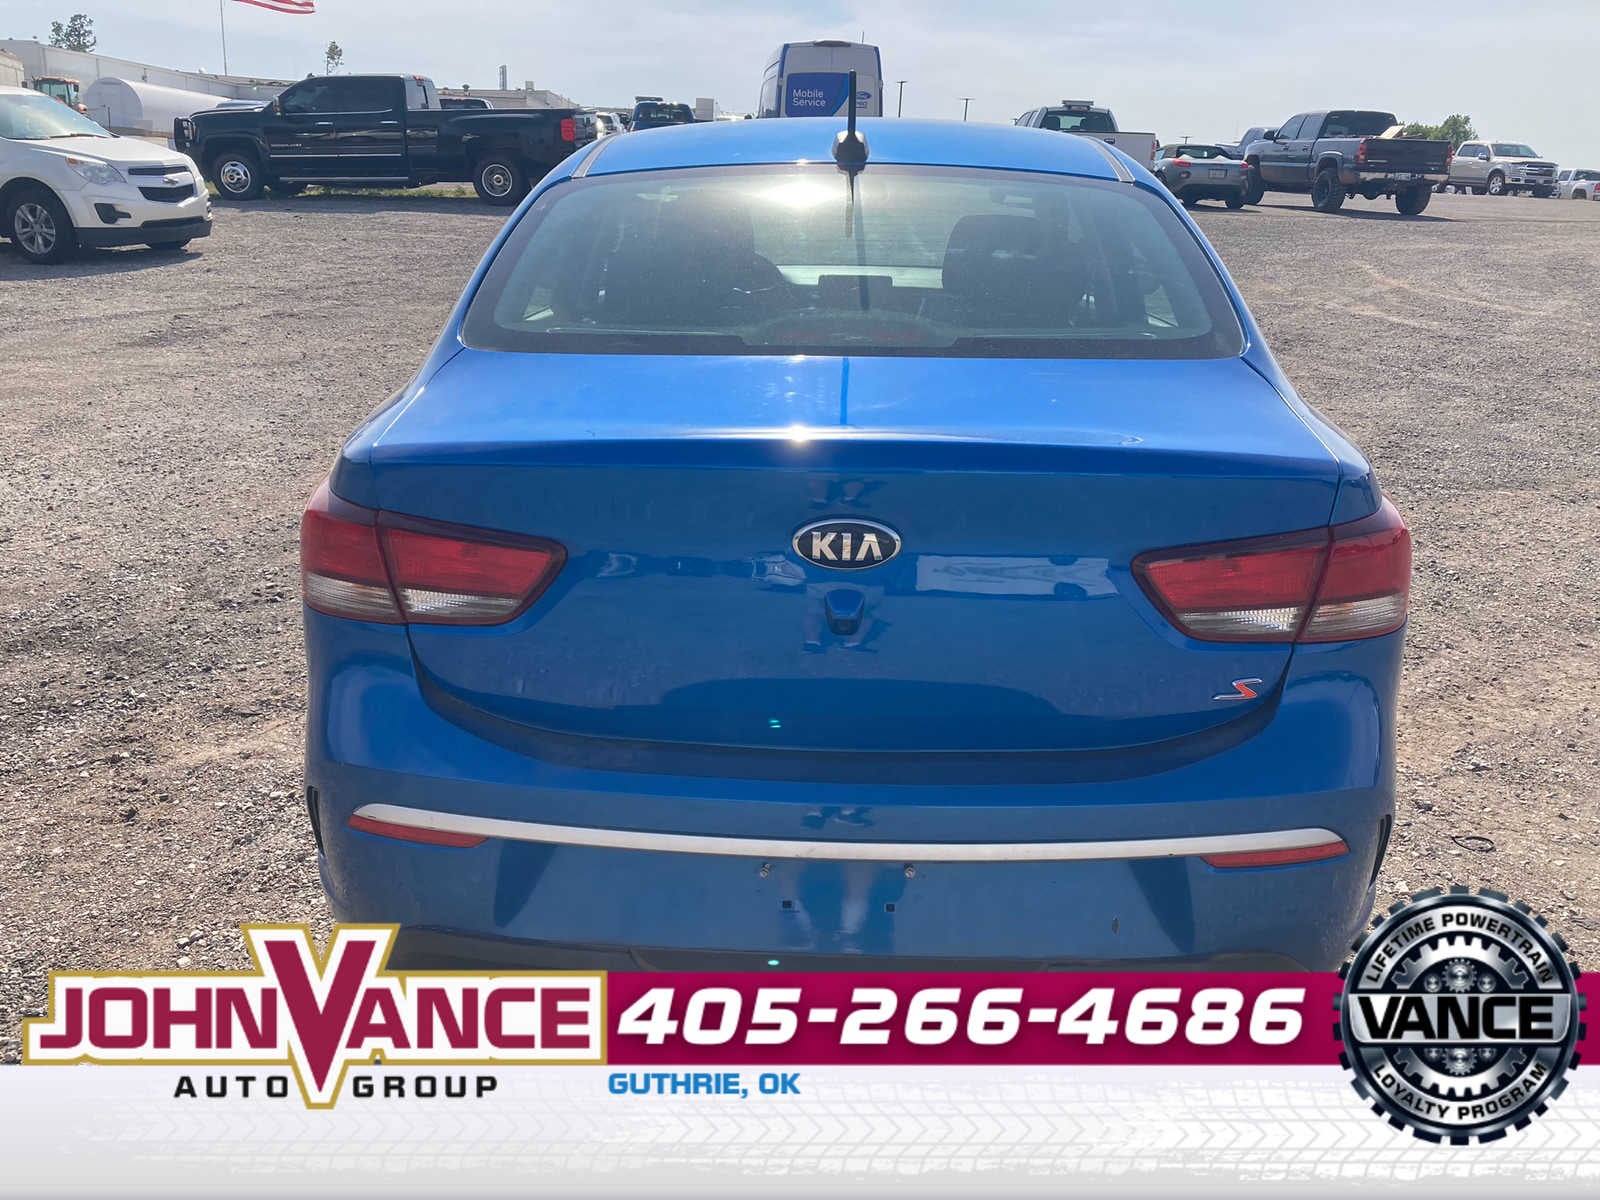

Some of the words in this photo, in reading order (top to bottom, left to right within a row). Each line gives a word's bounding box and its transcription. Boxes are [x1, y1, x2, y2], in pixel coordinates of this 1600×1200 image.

[792, 89, 824, 98] Mobile
[792, 98, 826, 107] Service
[811, 531, 883, 561] KIA
